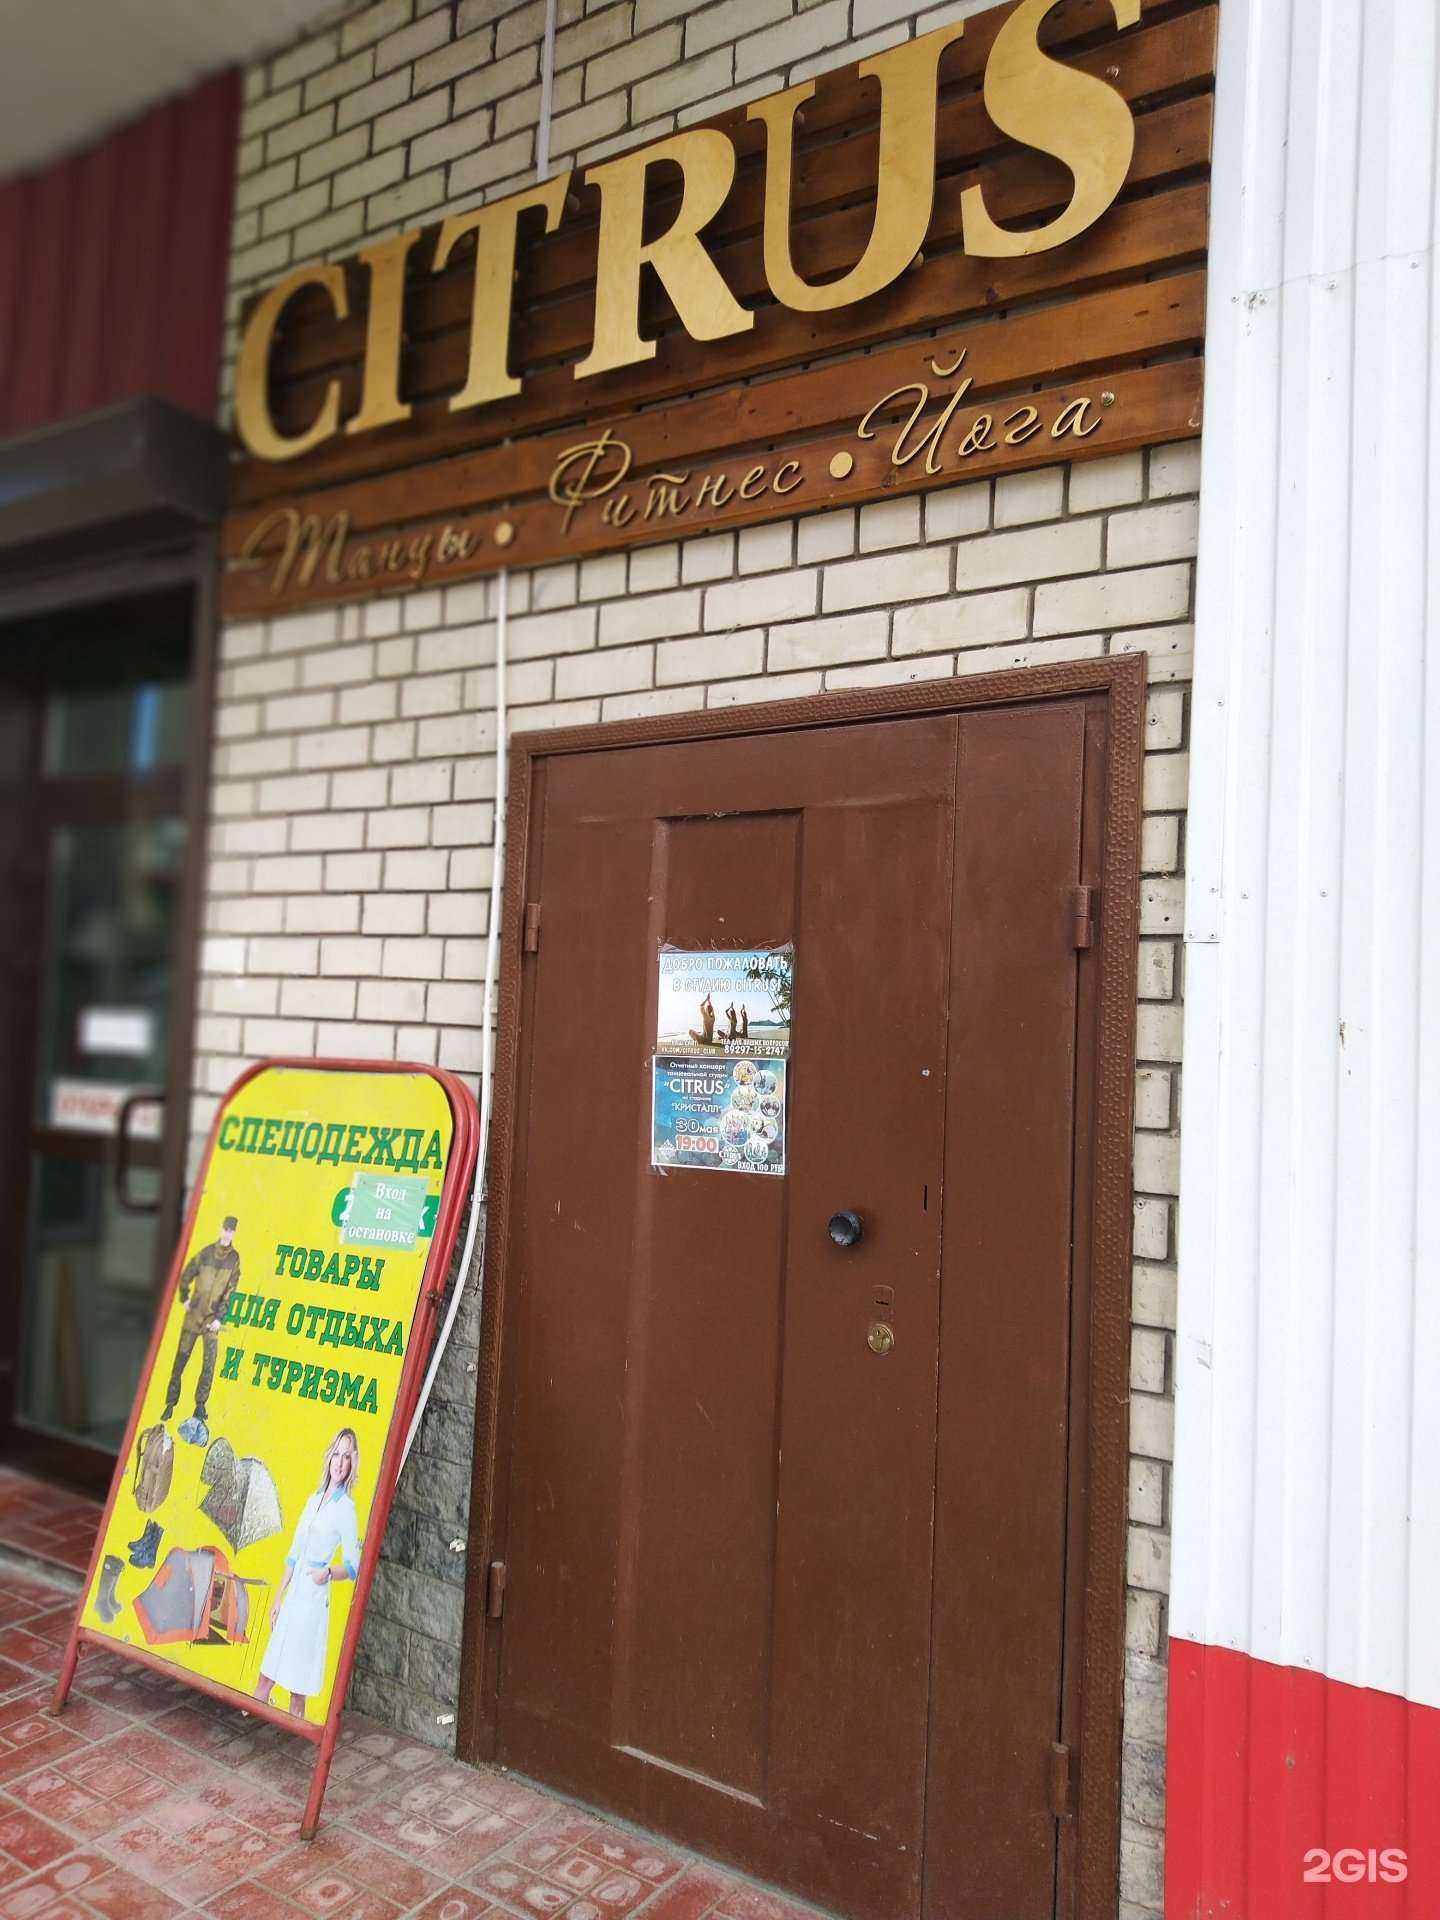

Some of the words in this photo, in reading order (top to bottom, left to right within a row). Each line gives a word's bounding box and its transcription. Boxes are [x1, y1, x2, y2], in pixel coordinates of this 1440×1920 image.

[235, 0, 1141, 461] CITRUS
[228, 507, 480, 593] Танцы
[548, 429, 804, 535] Фитнес
[857, 347, 1103, 475] Йога
[663, 957, 703, 972] ДОБРО
[707, 956, 787, 970] ПОЖАЛОВАТЬ
[683, 977, 731, 992] СТУДИЮ
[218, 1115, 442, 1172] СПЕЦОДЕЖДА
[677, 1136, 717, 1153] 19:00
[737, 1161, 755, 1171] ВХОД
[376, 1183, 407, 1201] Вход
[375, 1207, 392, 1220] на
[348, 1226, 416, 1244] остановке
[276, 1245, 385, 1292] ТОВАРЫ
[223, 1292, 281, 1330] ДЛЯ
[286, 1303, 404, 1356] ОТДЫХА
[220, 1347, 245, 1381] И
[252, 1353, 379, 1414] ТУРИЗМА
